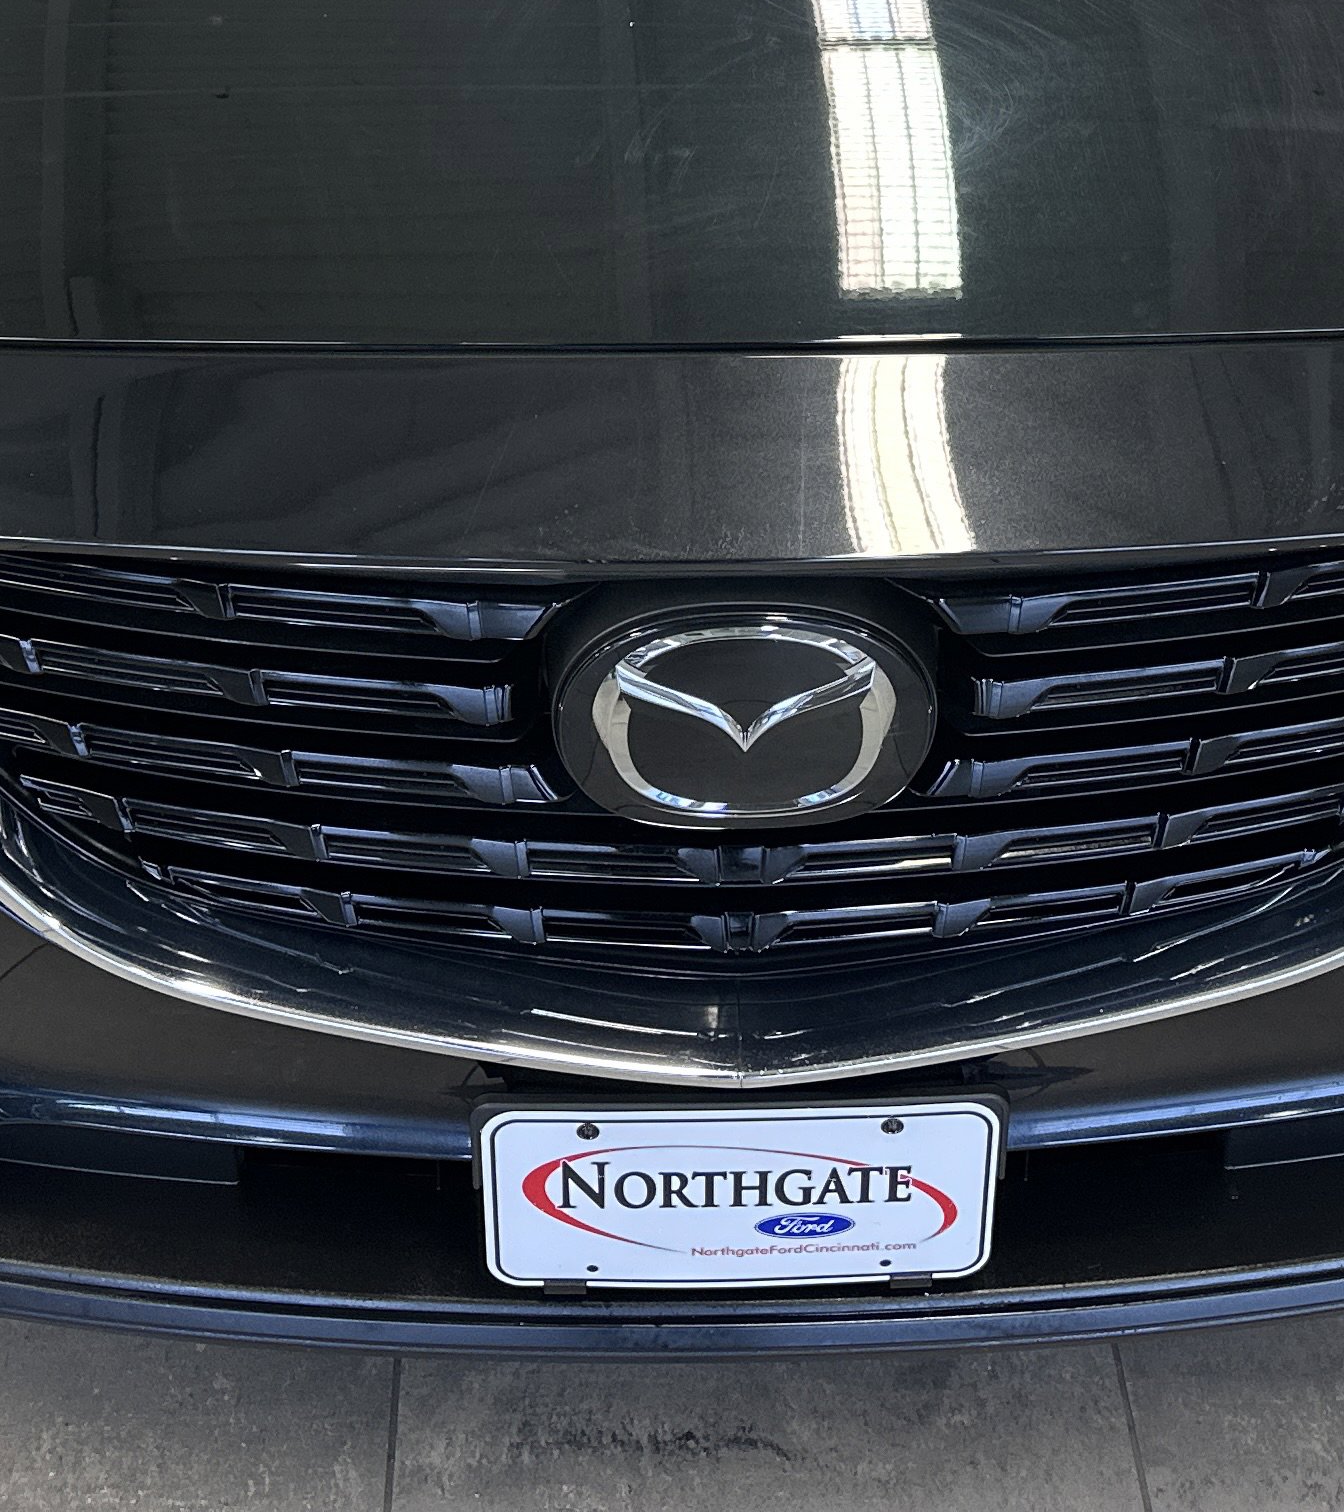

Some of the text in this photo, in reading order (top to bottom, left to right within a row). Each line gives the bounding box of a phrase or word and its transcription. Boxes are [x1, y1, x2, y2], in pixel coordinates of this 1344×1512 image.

[556, 1160, 913, 1209] NORTHGATE
[773, 1215, 835, 1235] Ford
[691, 1241, 918, 1259] NorthgateFordCincinnati.com
